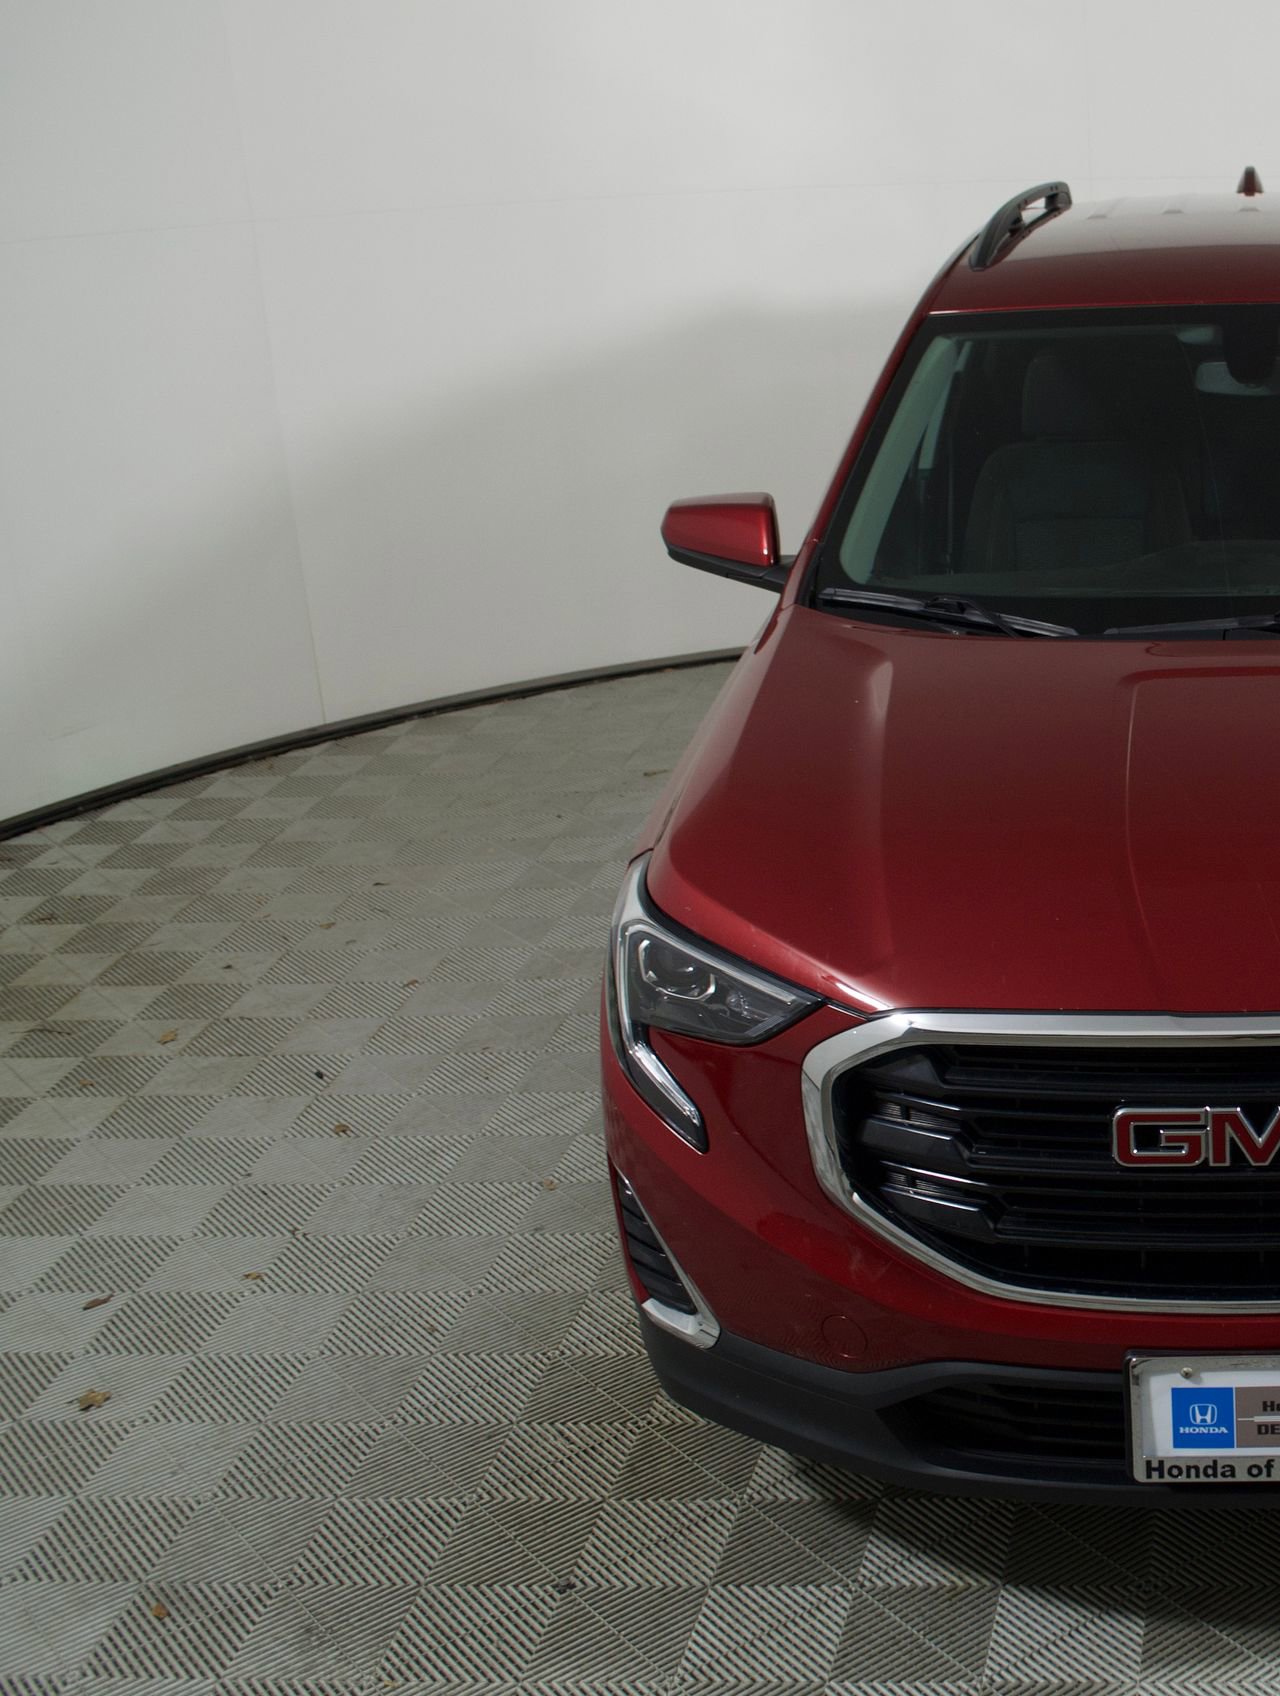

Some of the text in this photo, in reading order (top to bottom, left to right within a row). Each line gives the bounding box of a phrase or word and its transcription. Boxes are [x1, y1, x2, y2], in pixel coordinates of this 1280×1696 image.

[1179, 1426, 1229, 1434] HONDA
[1145, 1460, 1236, 1479] Honda
[1247, 1458, 1275, 1478] of
